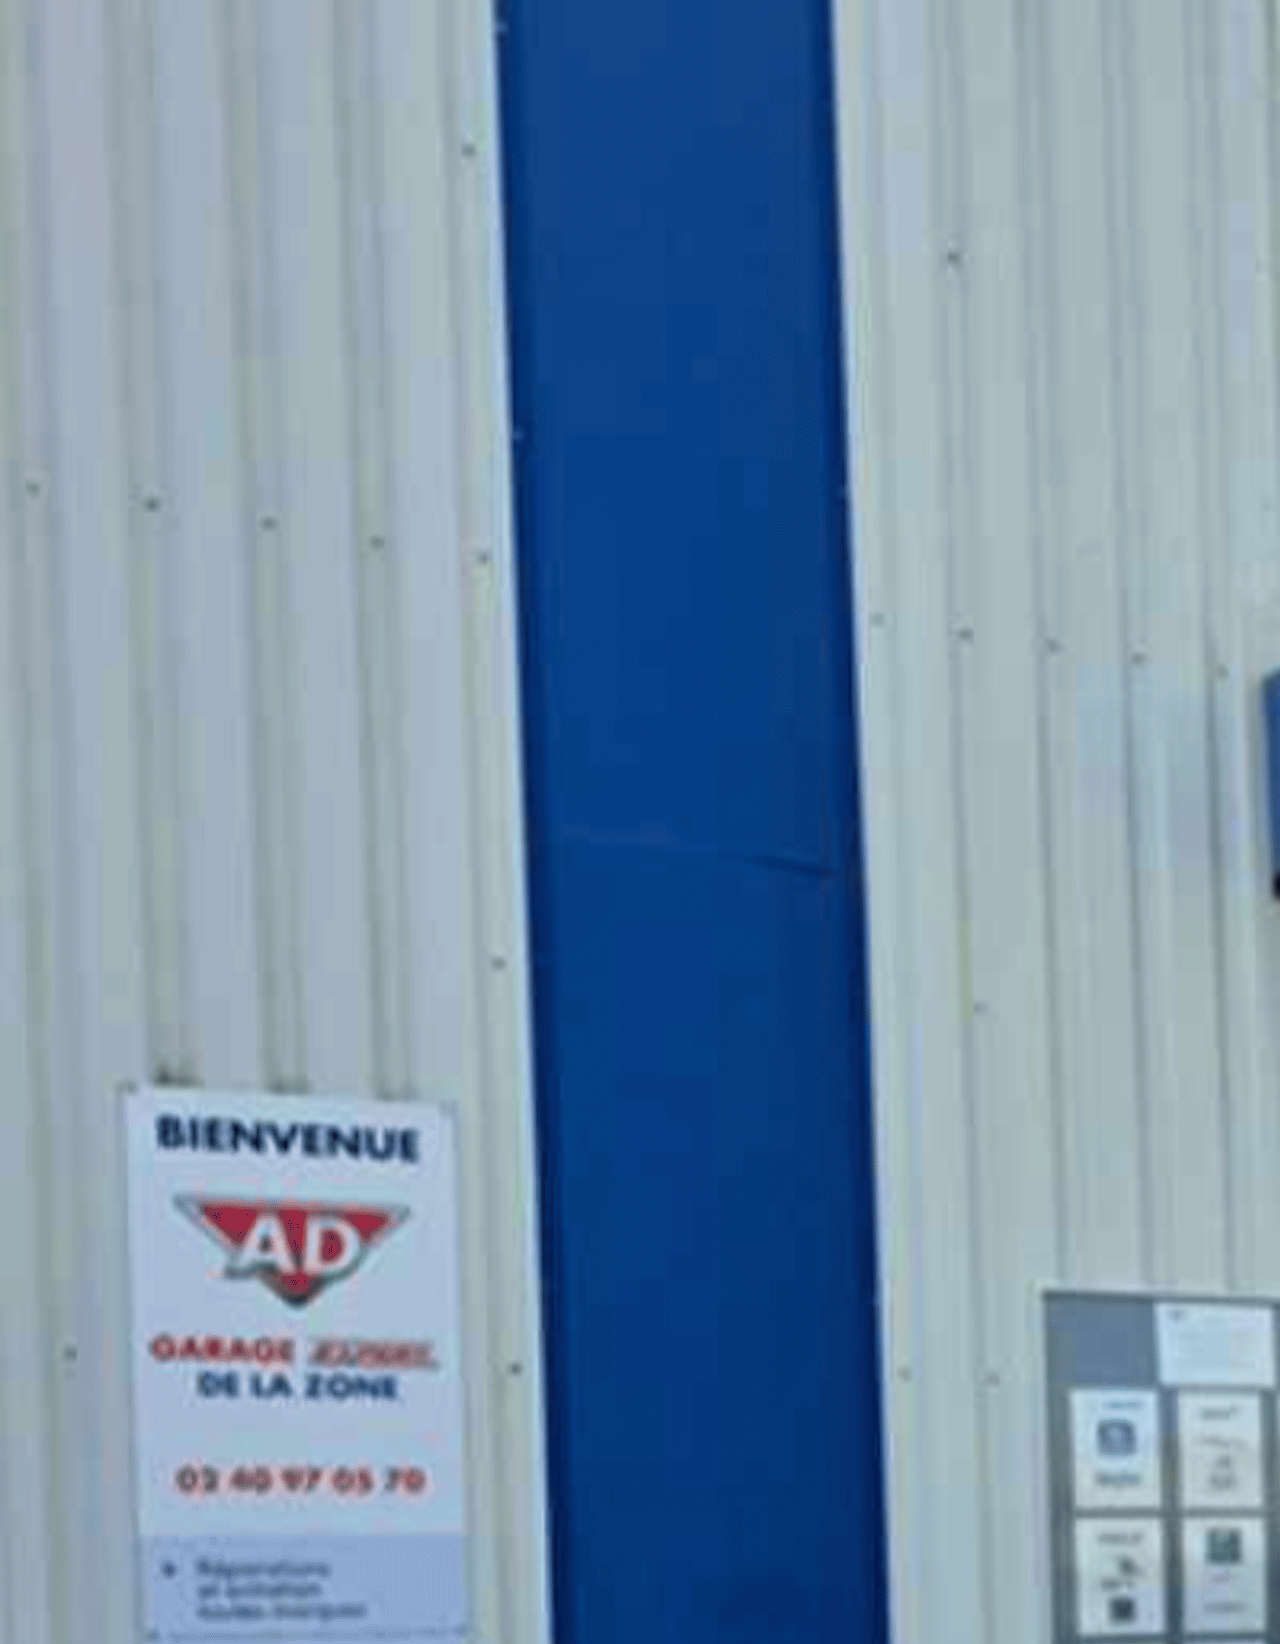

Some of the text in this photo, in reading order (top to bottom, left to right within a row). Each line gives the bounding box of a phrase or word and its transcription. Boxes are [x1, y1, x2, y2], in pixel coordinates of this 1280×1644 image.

[156, 1115, 419, 1162] BIENVENUE
[235, 1216, 358, 1274] AD
[149, 1334, 294, 1364] GARAGE
[197, 1372, 397, 1401] DE LA ZONE
